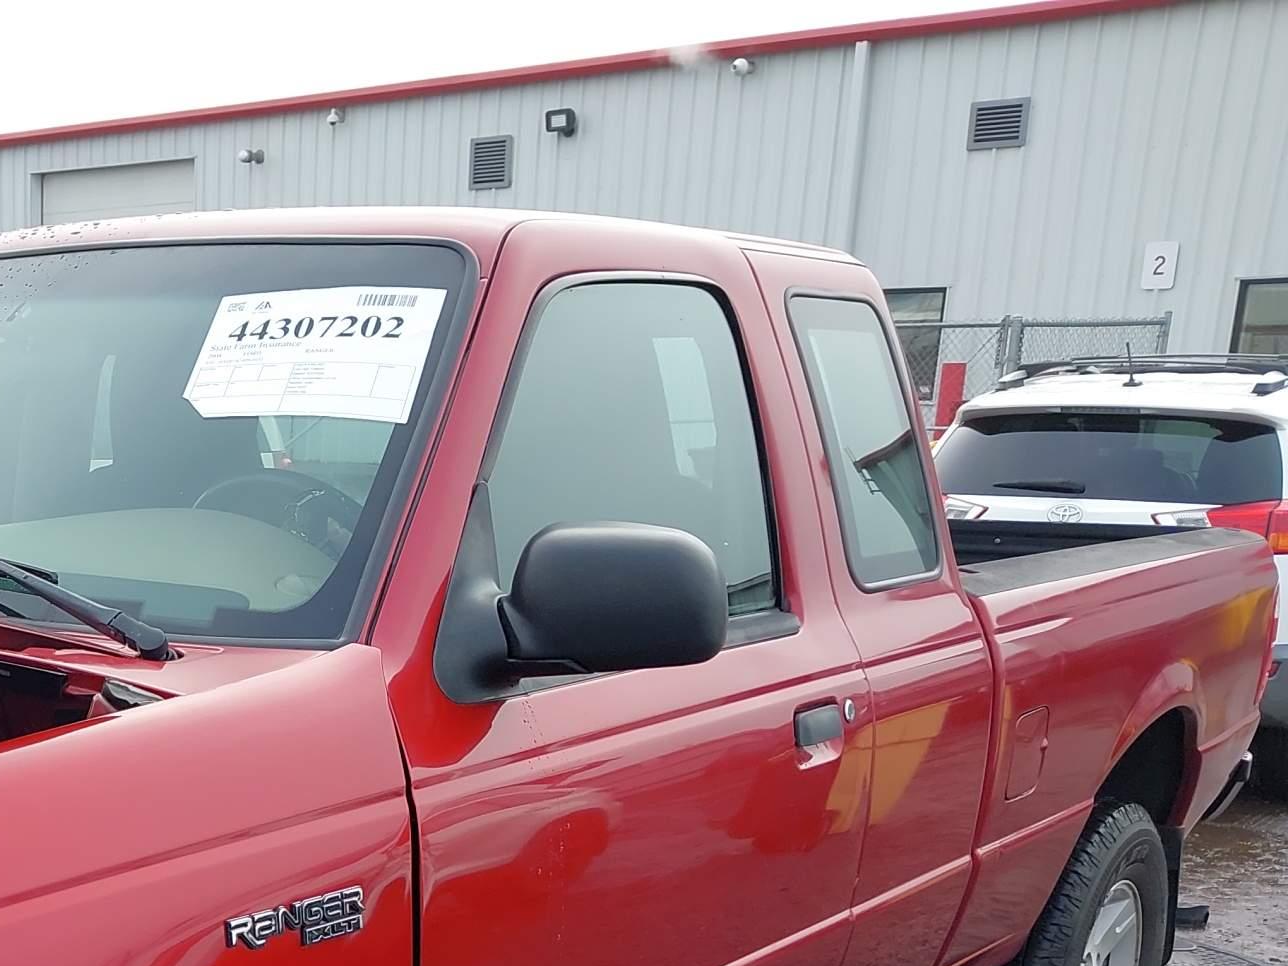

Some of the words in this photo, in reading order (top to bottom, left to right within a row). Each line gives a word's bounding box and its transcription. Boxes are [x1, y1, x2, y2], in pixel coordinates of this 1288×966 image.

[1153, 255, 1166, 276] 2
[228, 316, 404, 342] 44307202
[304, 914, 362, 944] XLT
